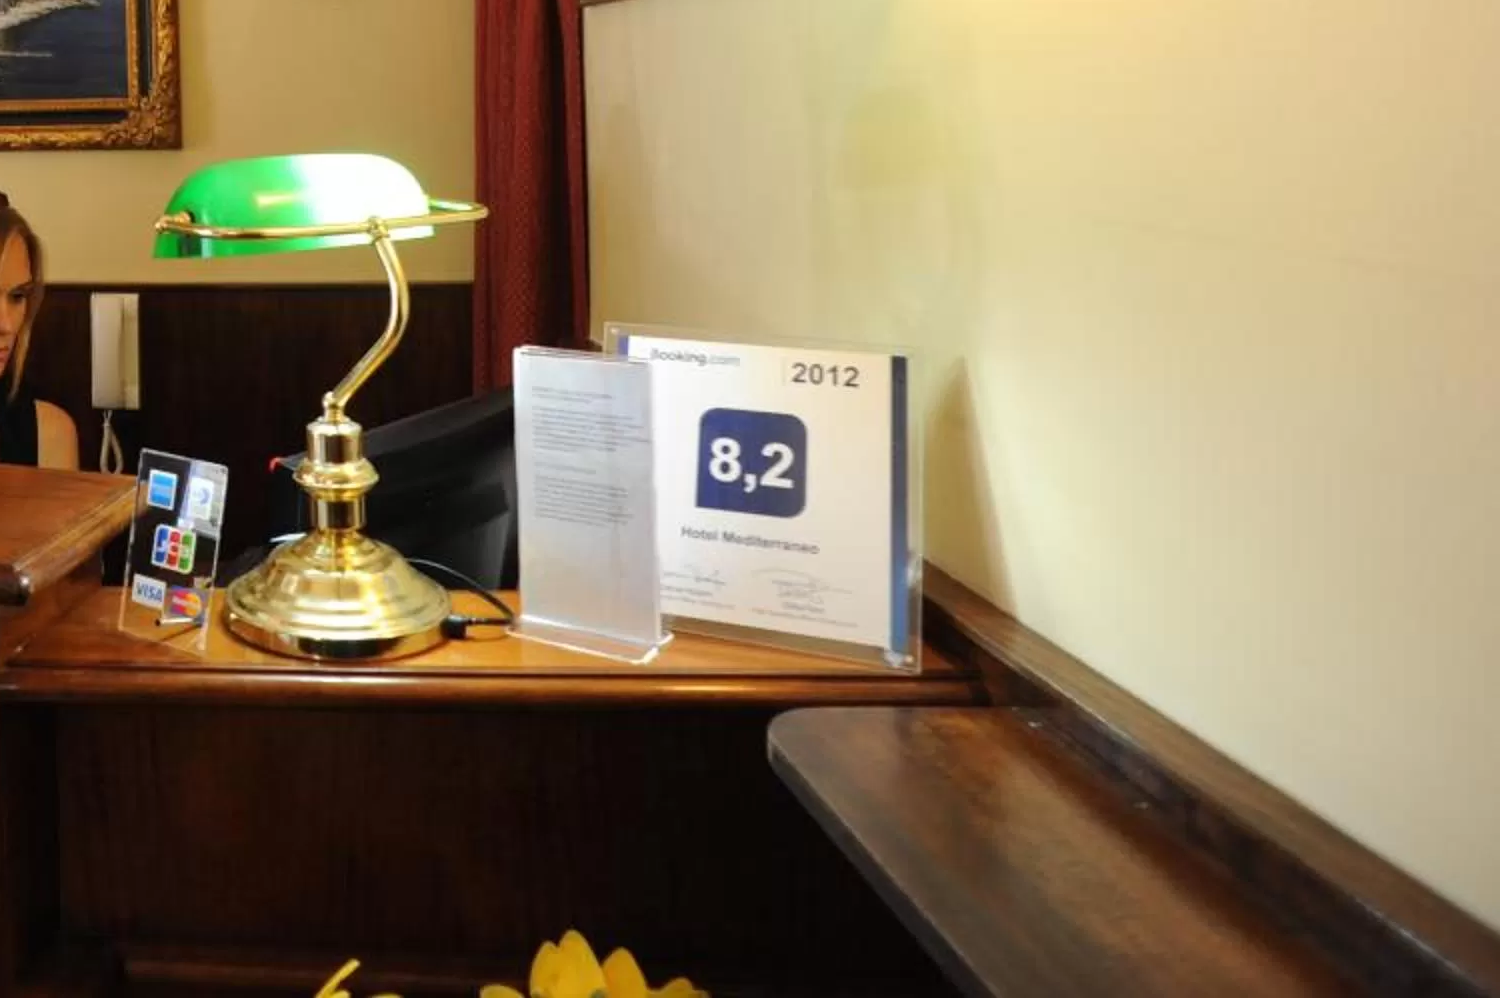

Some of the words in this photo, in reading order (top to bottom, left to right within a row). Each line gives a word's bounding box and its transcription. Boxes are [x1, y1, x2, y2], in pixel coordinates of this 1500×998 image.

[791, 362, 861, 388] 2012
[708, 437, 795, 493] 8,2
[680, 525, 718, 542] Hotel
[723, 530, 821, 555] Mediterraneo
[136, 581, 162, 603] VISA
